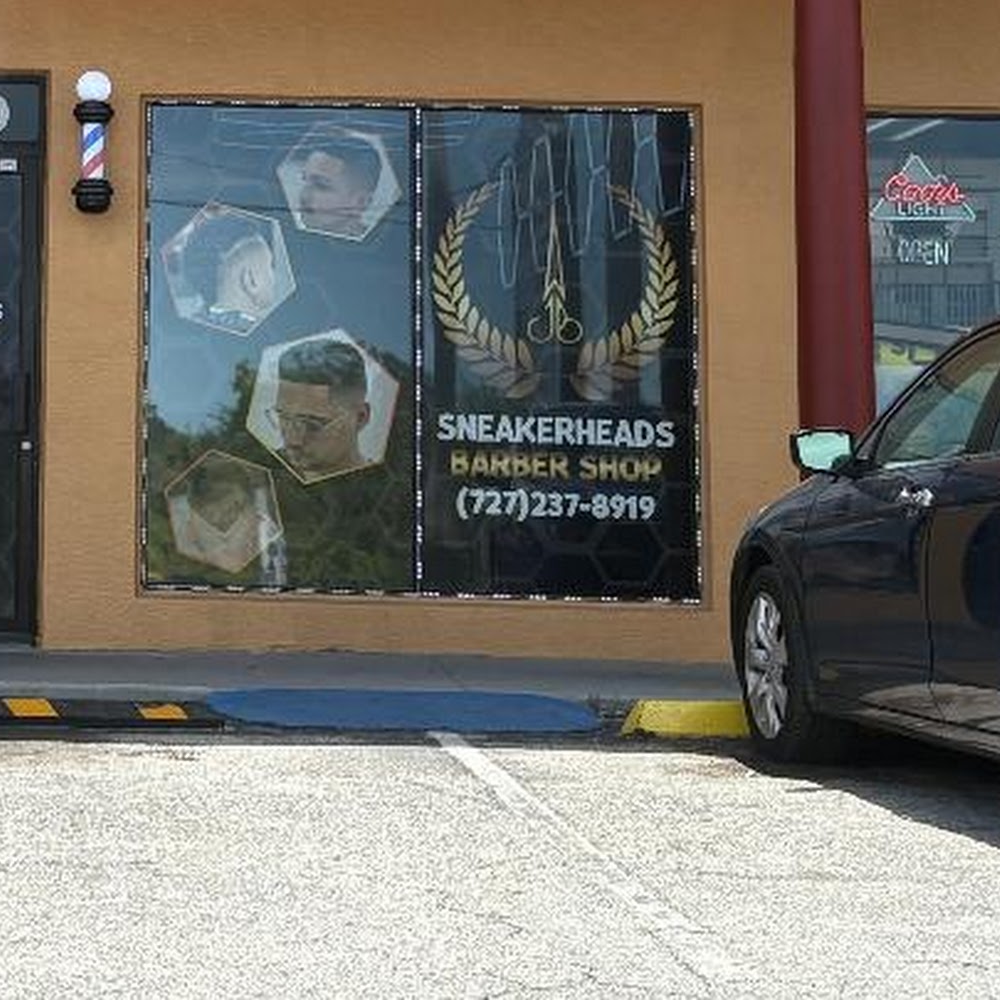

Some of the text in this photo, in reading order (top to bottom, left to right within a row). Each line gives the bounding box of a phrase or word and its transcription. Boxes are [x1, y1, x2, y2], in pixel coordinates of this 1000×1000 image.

[437, 412, 675, 448] SNEAKERHEADS
[450, 451, 662, 481] BARBER SHOP
[456, 486, 656, 522] (727)237-8919
